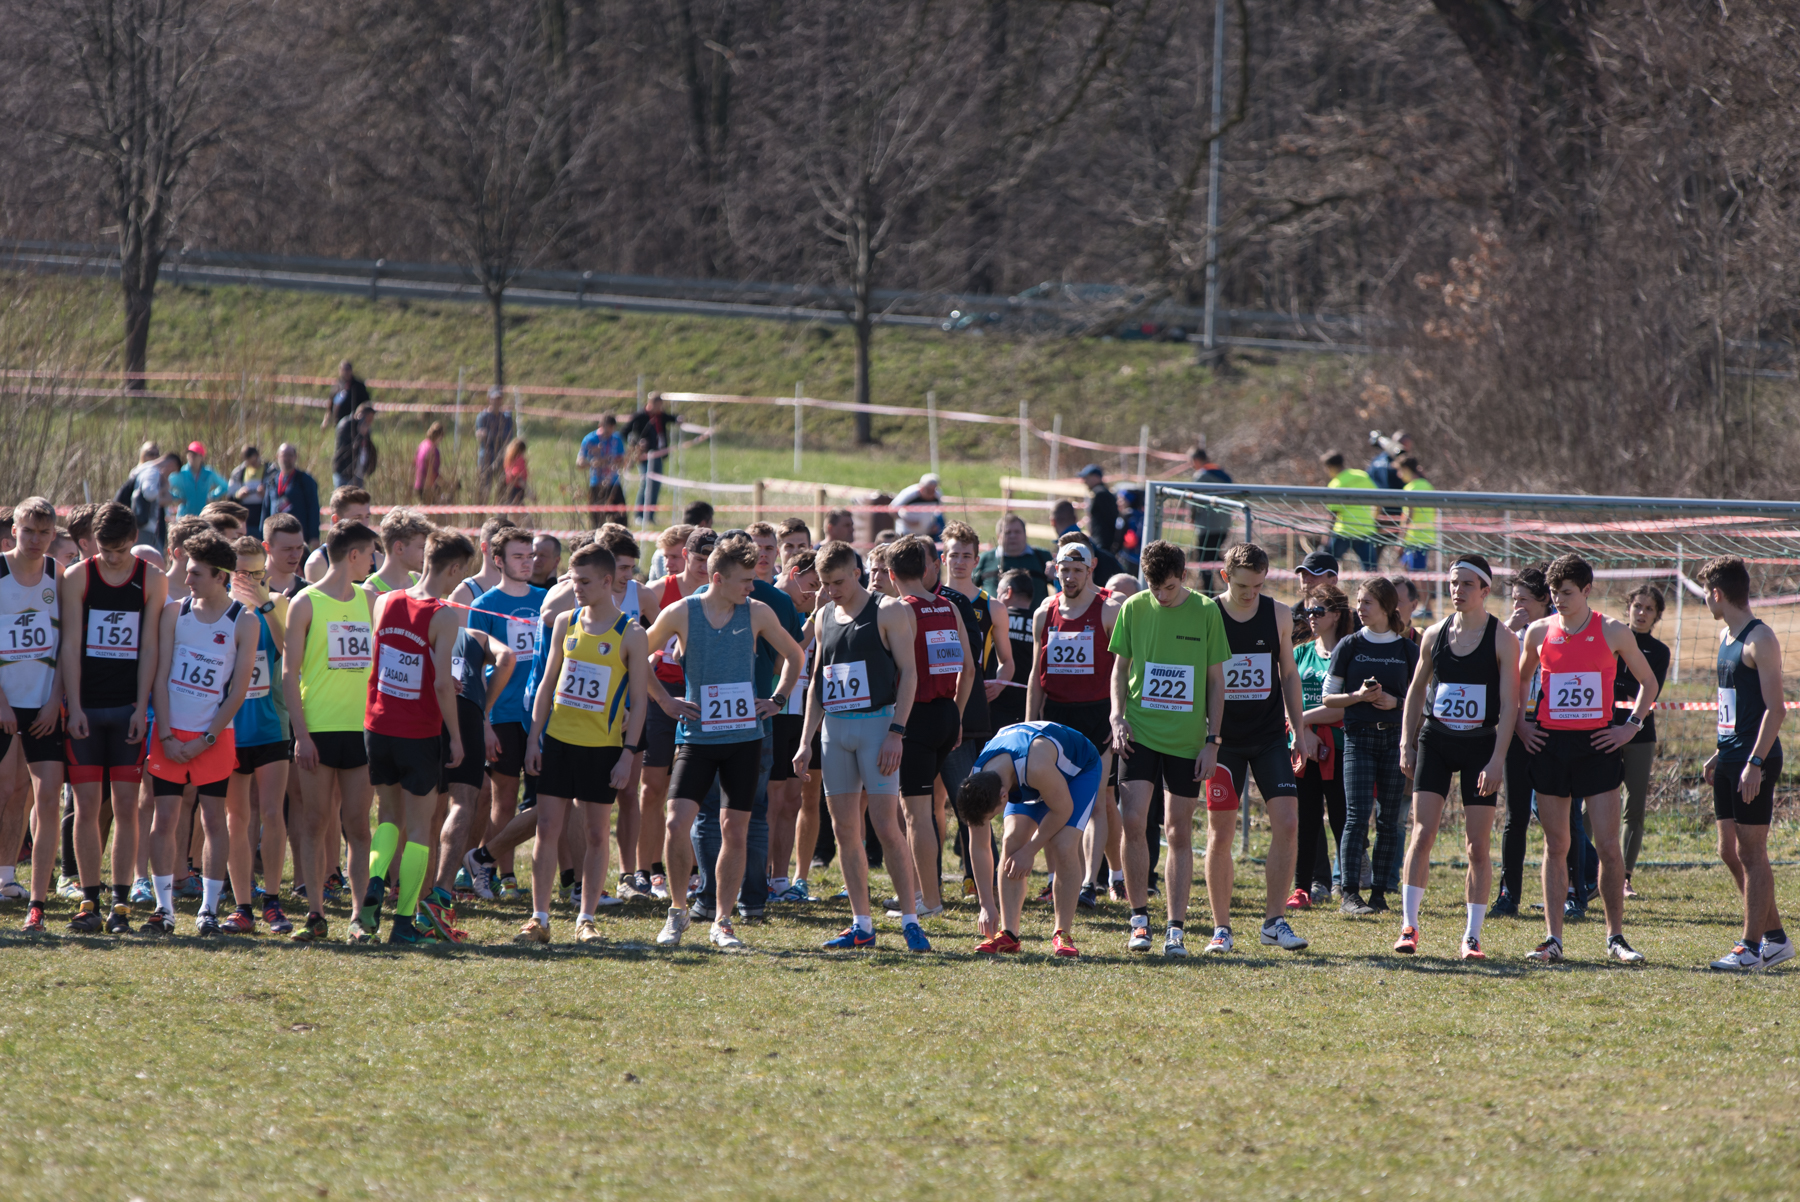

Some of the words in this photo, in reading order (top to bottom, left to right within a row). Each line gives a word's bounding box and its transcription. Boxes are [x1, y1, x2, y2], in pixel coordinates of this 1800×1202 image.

[8, 627, 46, 648] 150
[96, 626, 132, 645] 152
[337, 637, 369, 655] 184
[1053, 646, 1086, 663] 326
[399, 653, 419, 667] 204
[1355, 654, 1405, 665] Champion
[181, 662, 216, 687] 165
[384, 666, 408, 683] ZASADA
[1150, 668, 1186, 678] 4MOVE
[1226, 669, 1265, 688] 253
[563, 674, 600, 698] 213
[826, 678, 860, 700] 219
[1148, 679, 1186, 699] 222
[1557, 688, 1595, 707] 259
[709, 698, 748, 719] 218
[1441, 699, 1478, 719] 250
